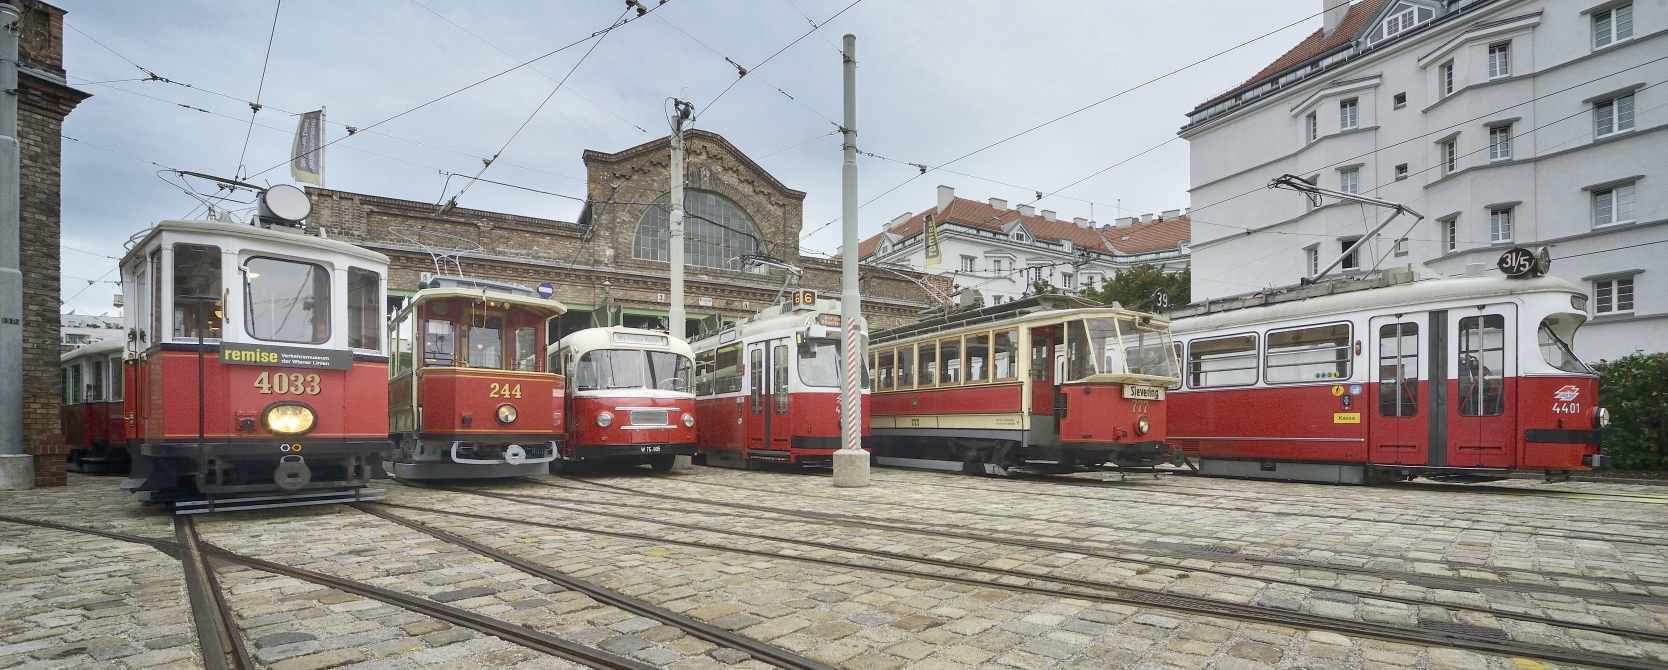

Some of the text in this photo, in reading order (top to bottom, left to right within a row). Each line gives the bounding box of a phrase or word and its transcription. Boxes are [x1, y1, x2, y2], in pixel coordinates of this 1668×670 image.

[1503, 251, 1530, 273] 31/5
[804, 293, 812, 302] 6
[1156, 292, 1168, 308] 39
[224, 349, 278, 362] remise
[281, 353, 329, 361] Verkehrsmuseum
[254, 371, 321, 395] 4033
[489, 382, 522, 399] 244
[1130, 386, 1158, 399] Sievering
[1132, 400, 1148, 413] 777
[1552, 402, 1580, 414] 4401
